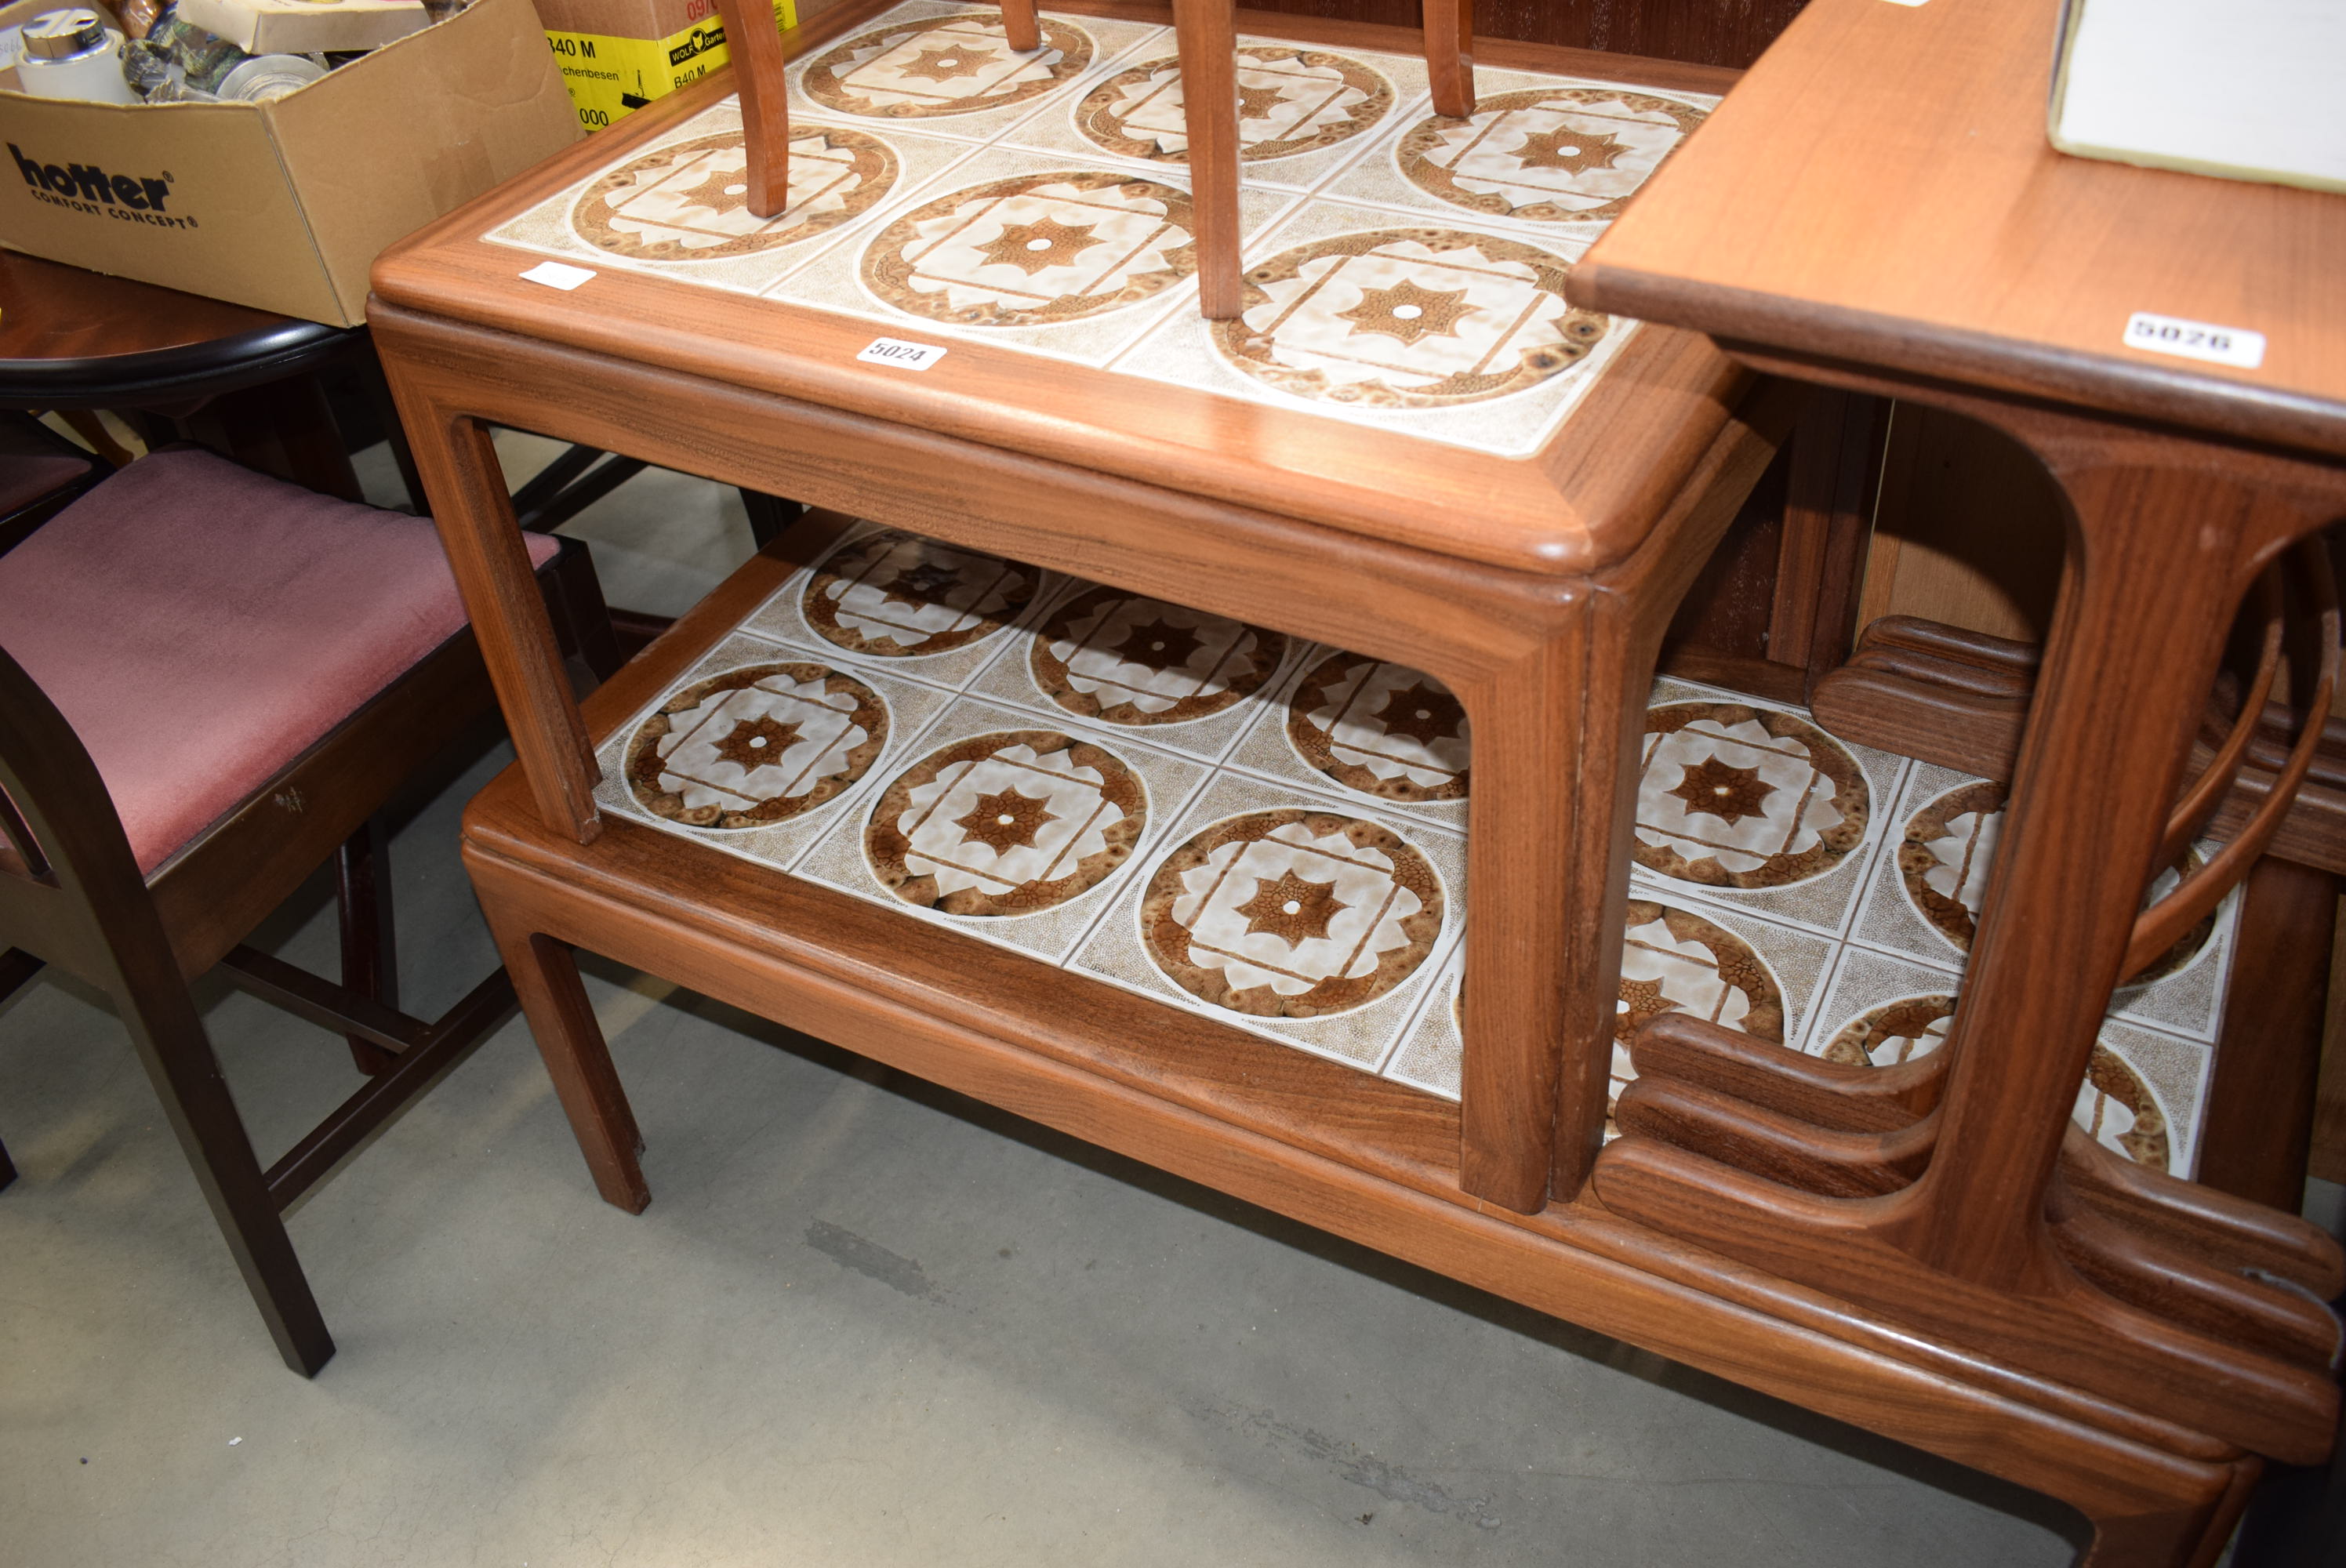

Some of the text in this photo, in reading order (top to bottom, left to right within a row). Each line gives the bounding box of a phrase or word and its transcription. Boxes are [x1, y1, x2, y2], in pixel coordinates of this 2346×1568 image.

[580, 40, 596, 58] M
[672, 32, 726, 62] WOLF Garte
[559, 65, 619, 81] chenbesen
[674, 64, 706, 89] B40 M
[579, 107, 609, 126] 000
[31, 189, 101, 216] COMFORT
[2134, 320, 2232, 350] 5026
[869, 343, 927, 361] 5024
